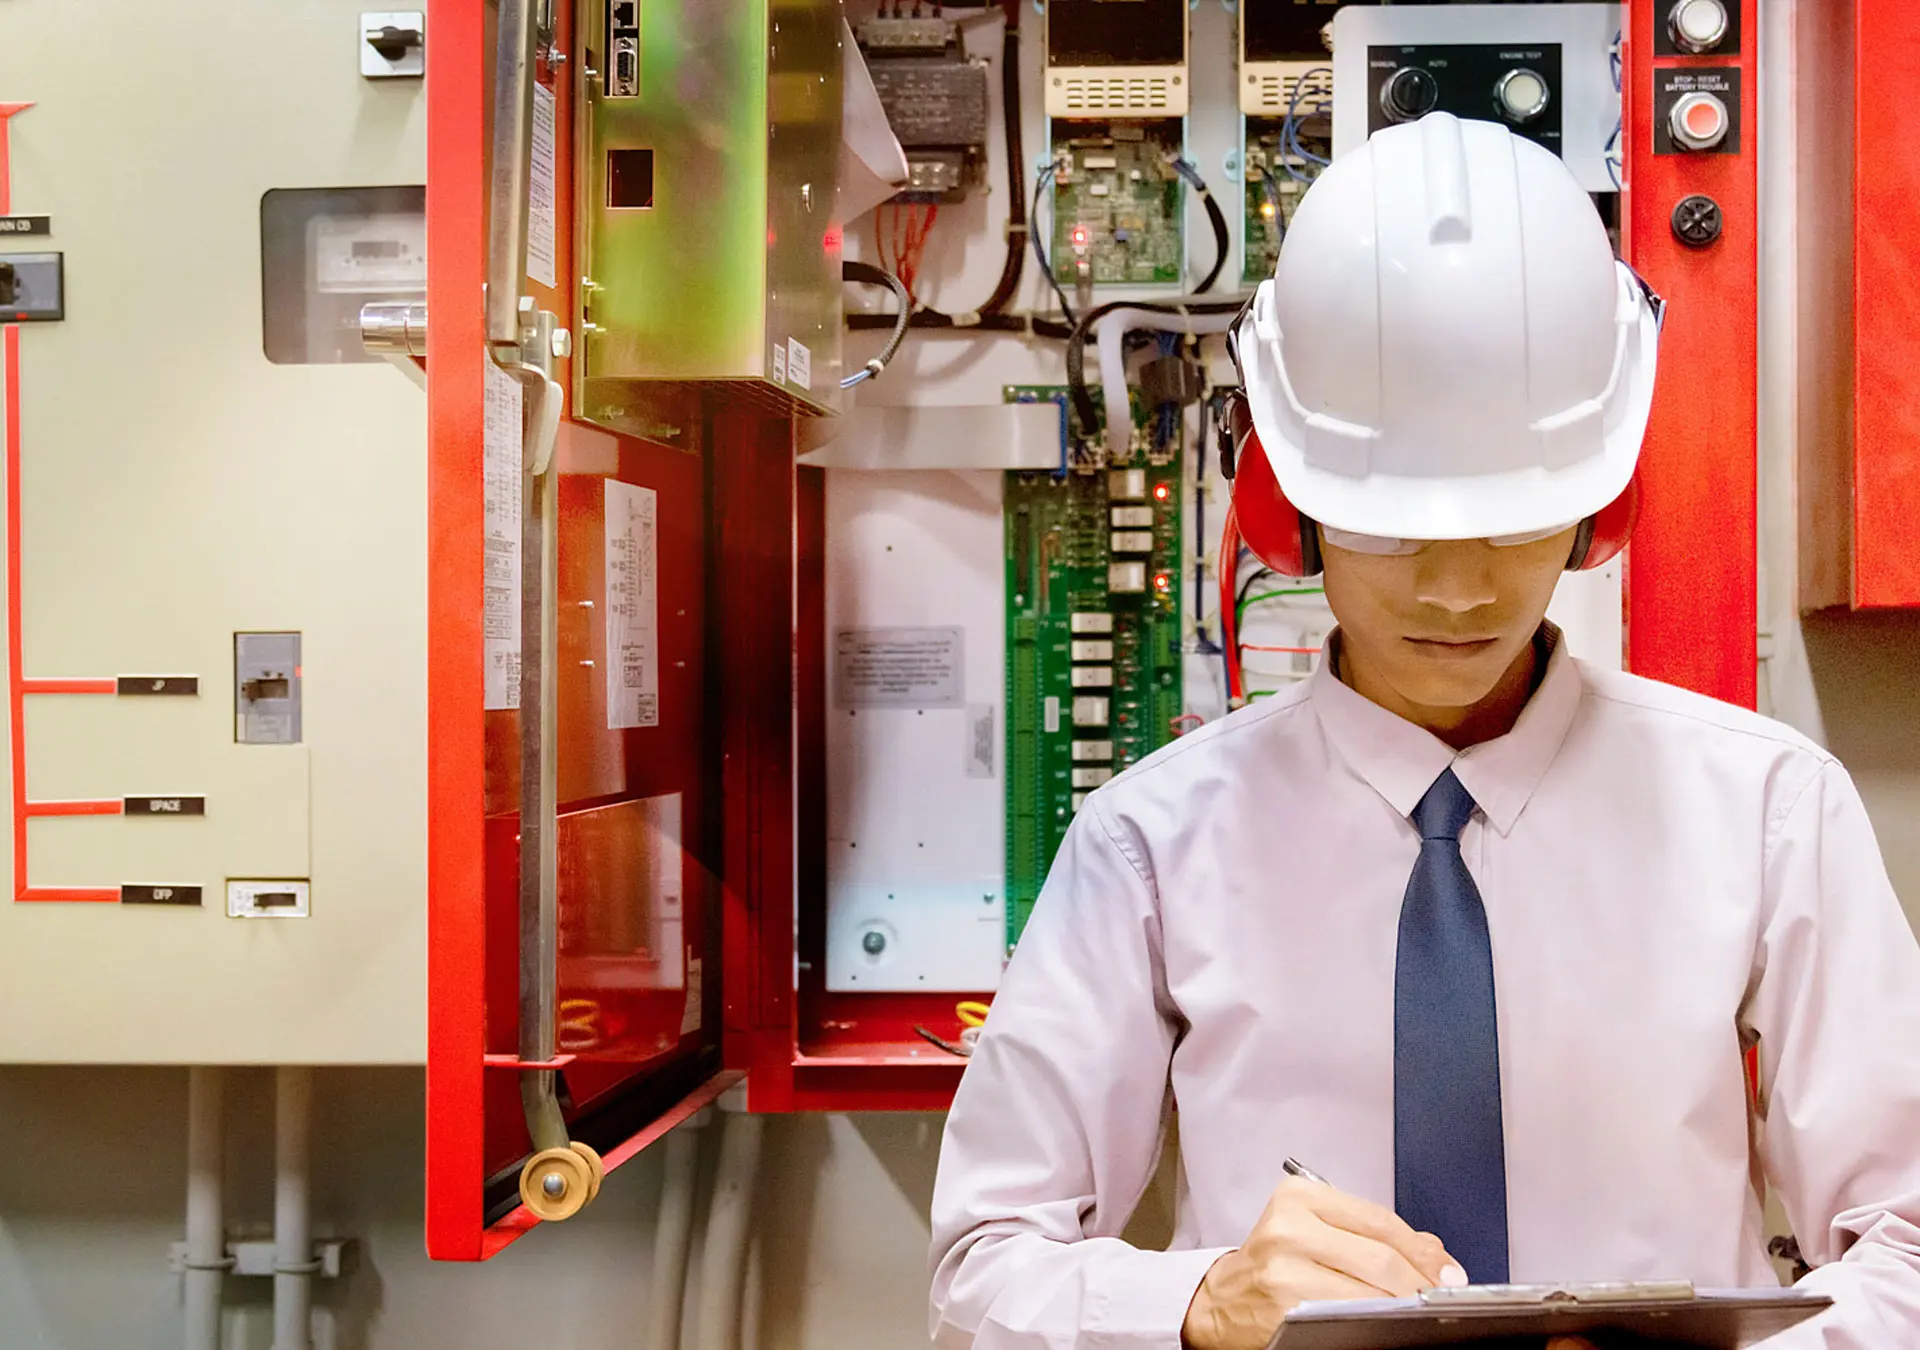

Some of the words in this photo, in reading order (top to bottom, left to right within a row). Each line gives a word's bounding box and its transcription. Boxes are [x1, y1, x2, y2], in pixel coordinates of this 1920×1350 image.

[1665, 83, 1696, 92] BATTERY
[1697, 82, 1729, 91] TROUBLE
[149, 799, 181, 812] SPACE
